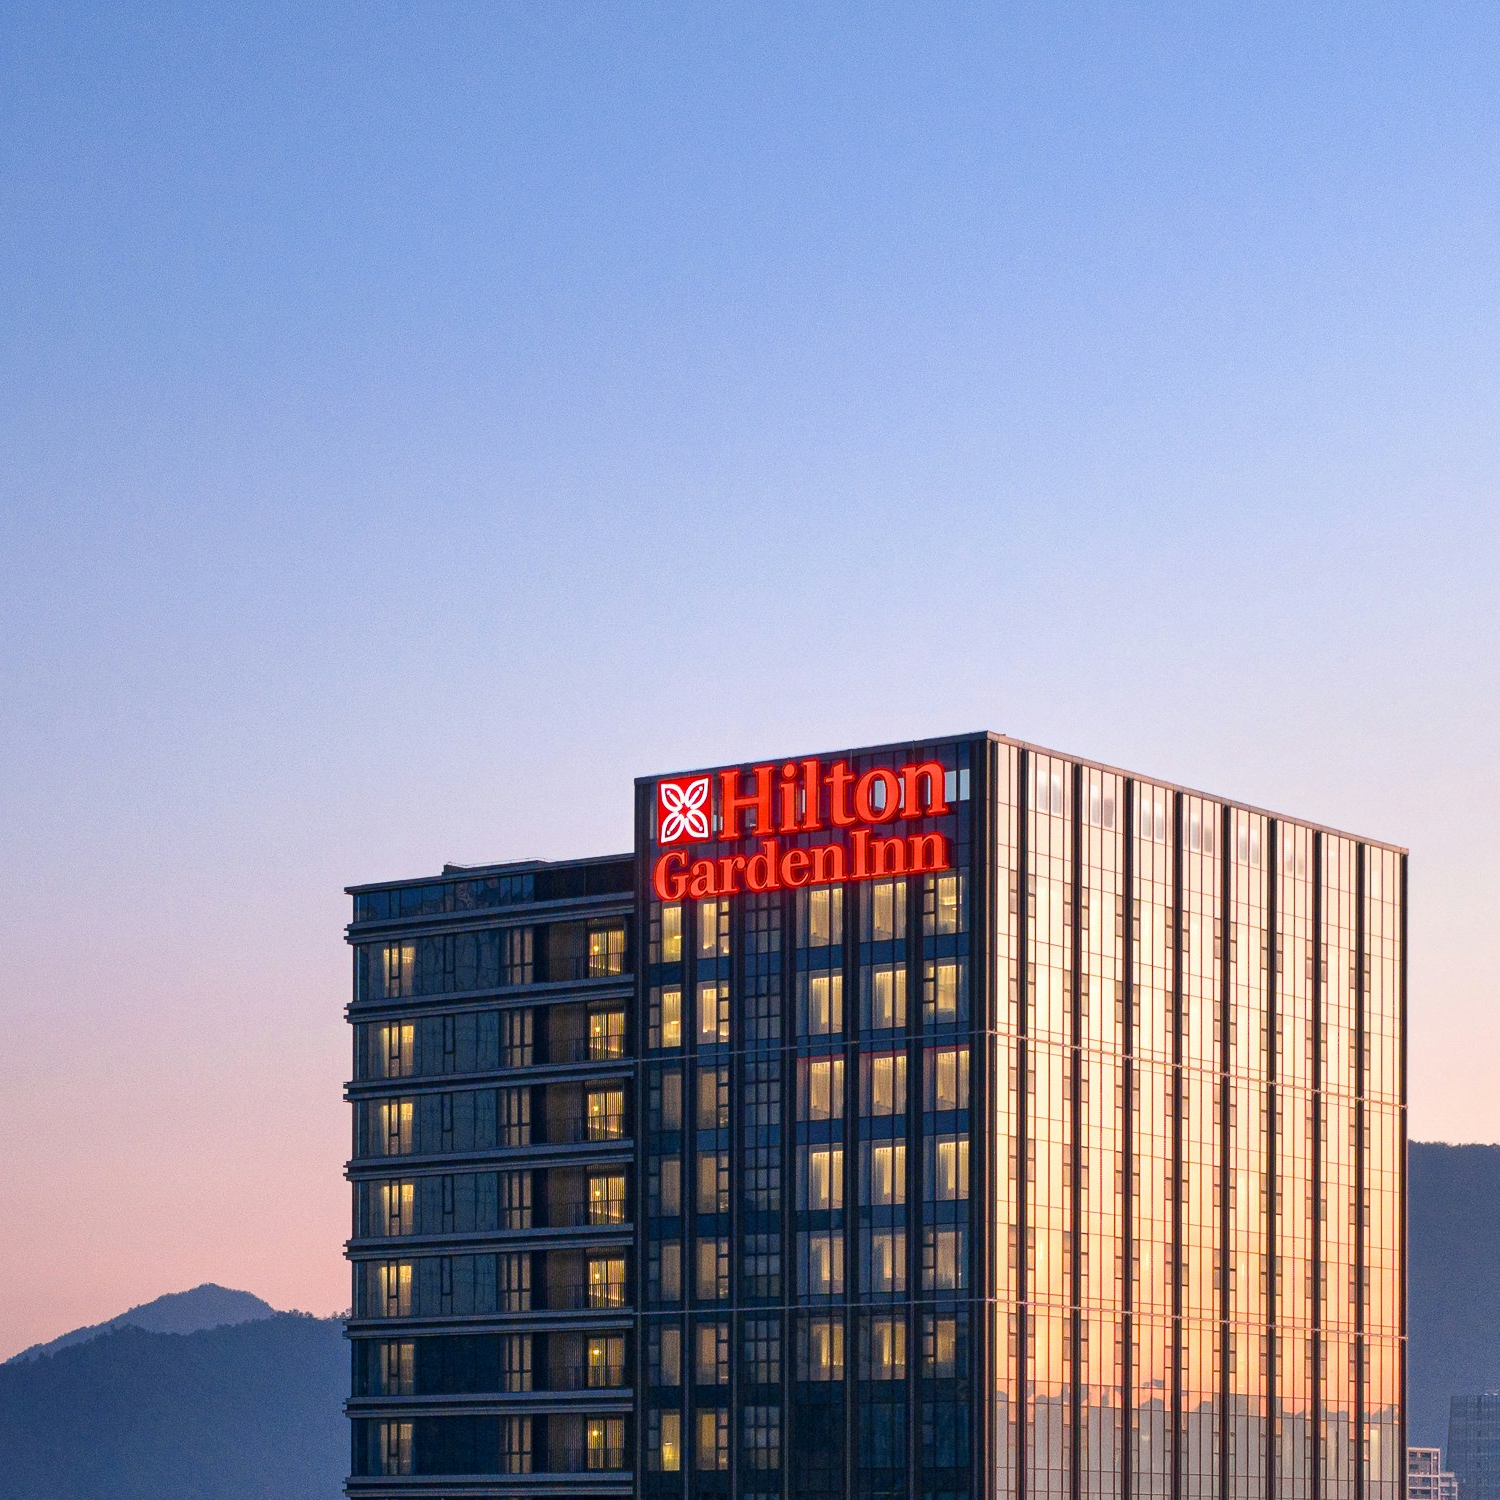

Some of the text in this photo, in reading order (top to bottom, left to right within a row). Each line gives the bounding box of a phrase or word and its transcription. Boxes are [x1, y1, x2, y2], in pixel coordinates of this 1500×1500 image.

[719, 758, 948, 840] Hilton
[653, 828, 950, 902] Garden Inn
